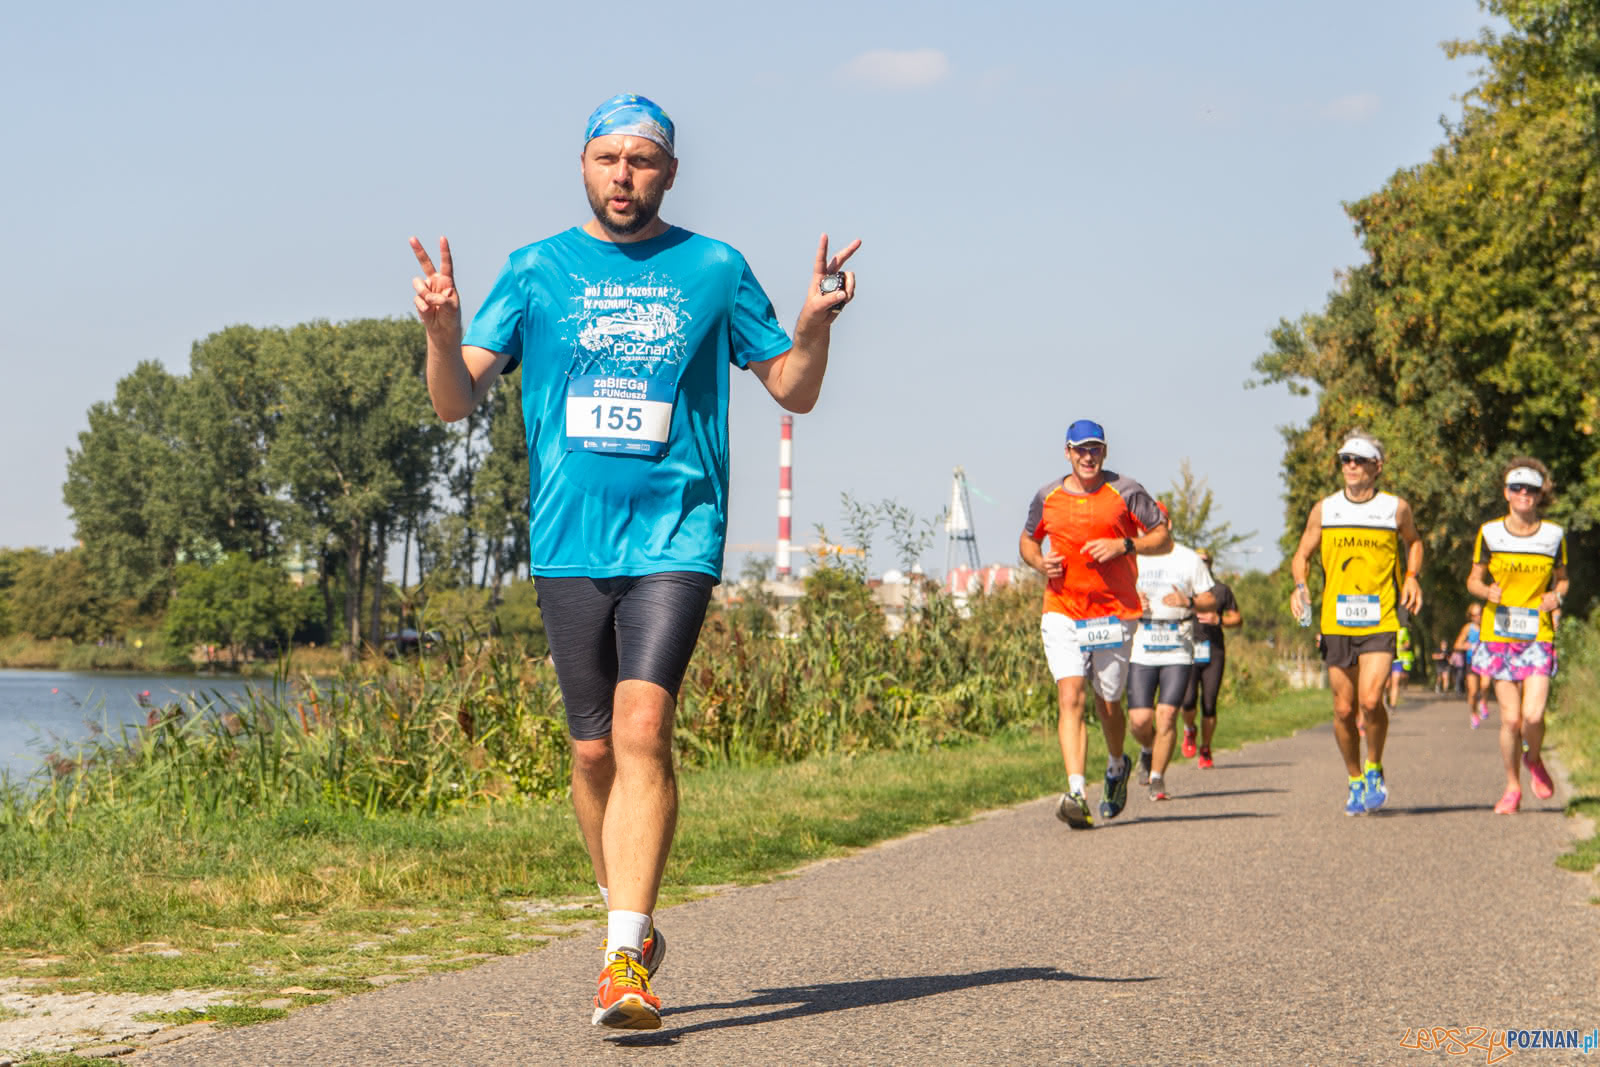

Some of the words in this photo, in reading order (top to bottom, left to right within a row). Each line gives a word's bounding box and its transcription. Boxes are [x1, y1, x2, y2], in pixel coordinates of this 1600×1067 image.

[593, 377, 648, 393] zaBIEGaj
[593, 389, 599, 397] o
[601, 389, 647, 400] FUNdusze
[591, 404, 643, 432] 155
[1345, 606, 1368, 618] 049
[1087, 629, 1111, 642] 042
